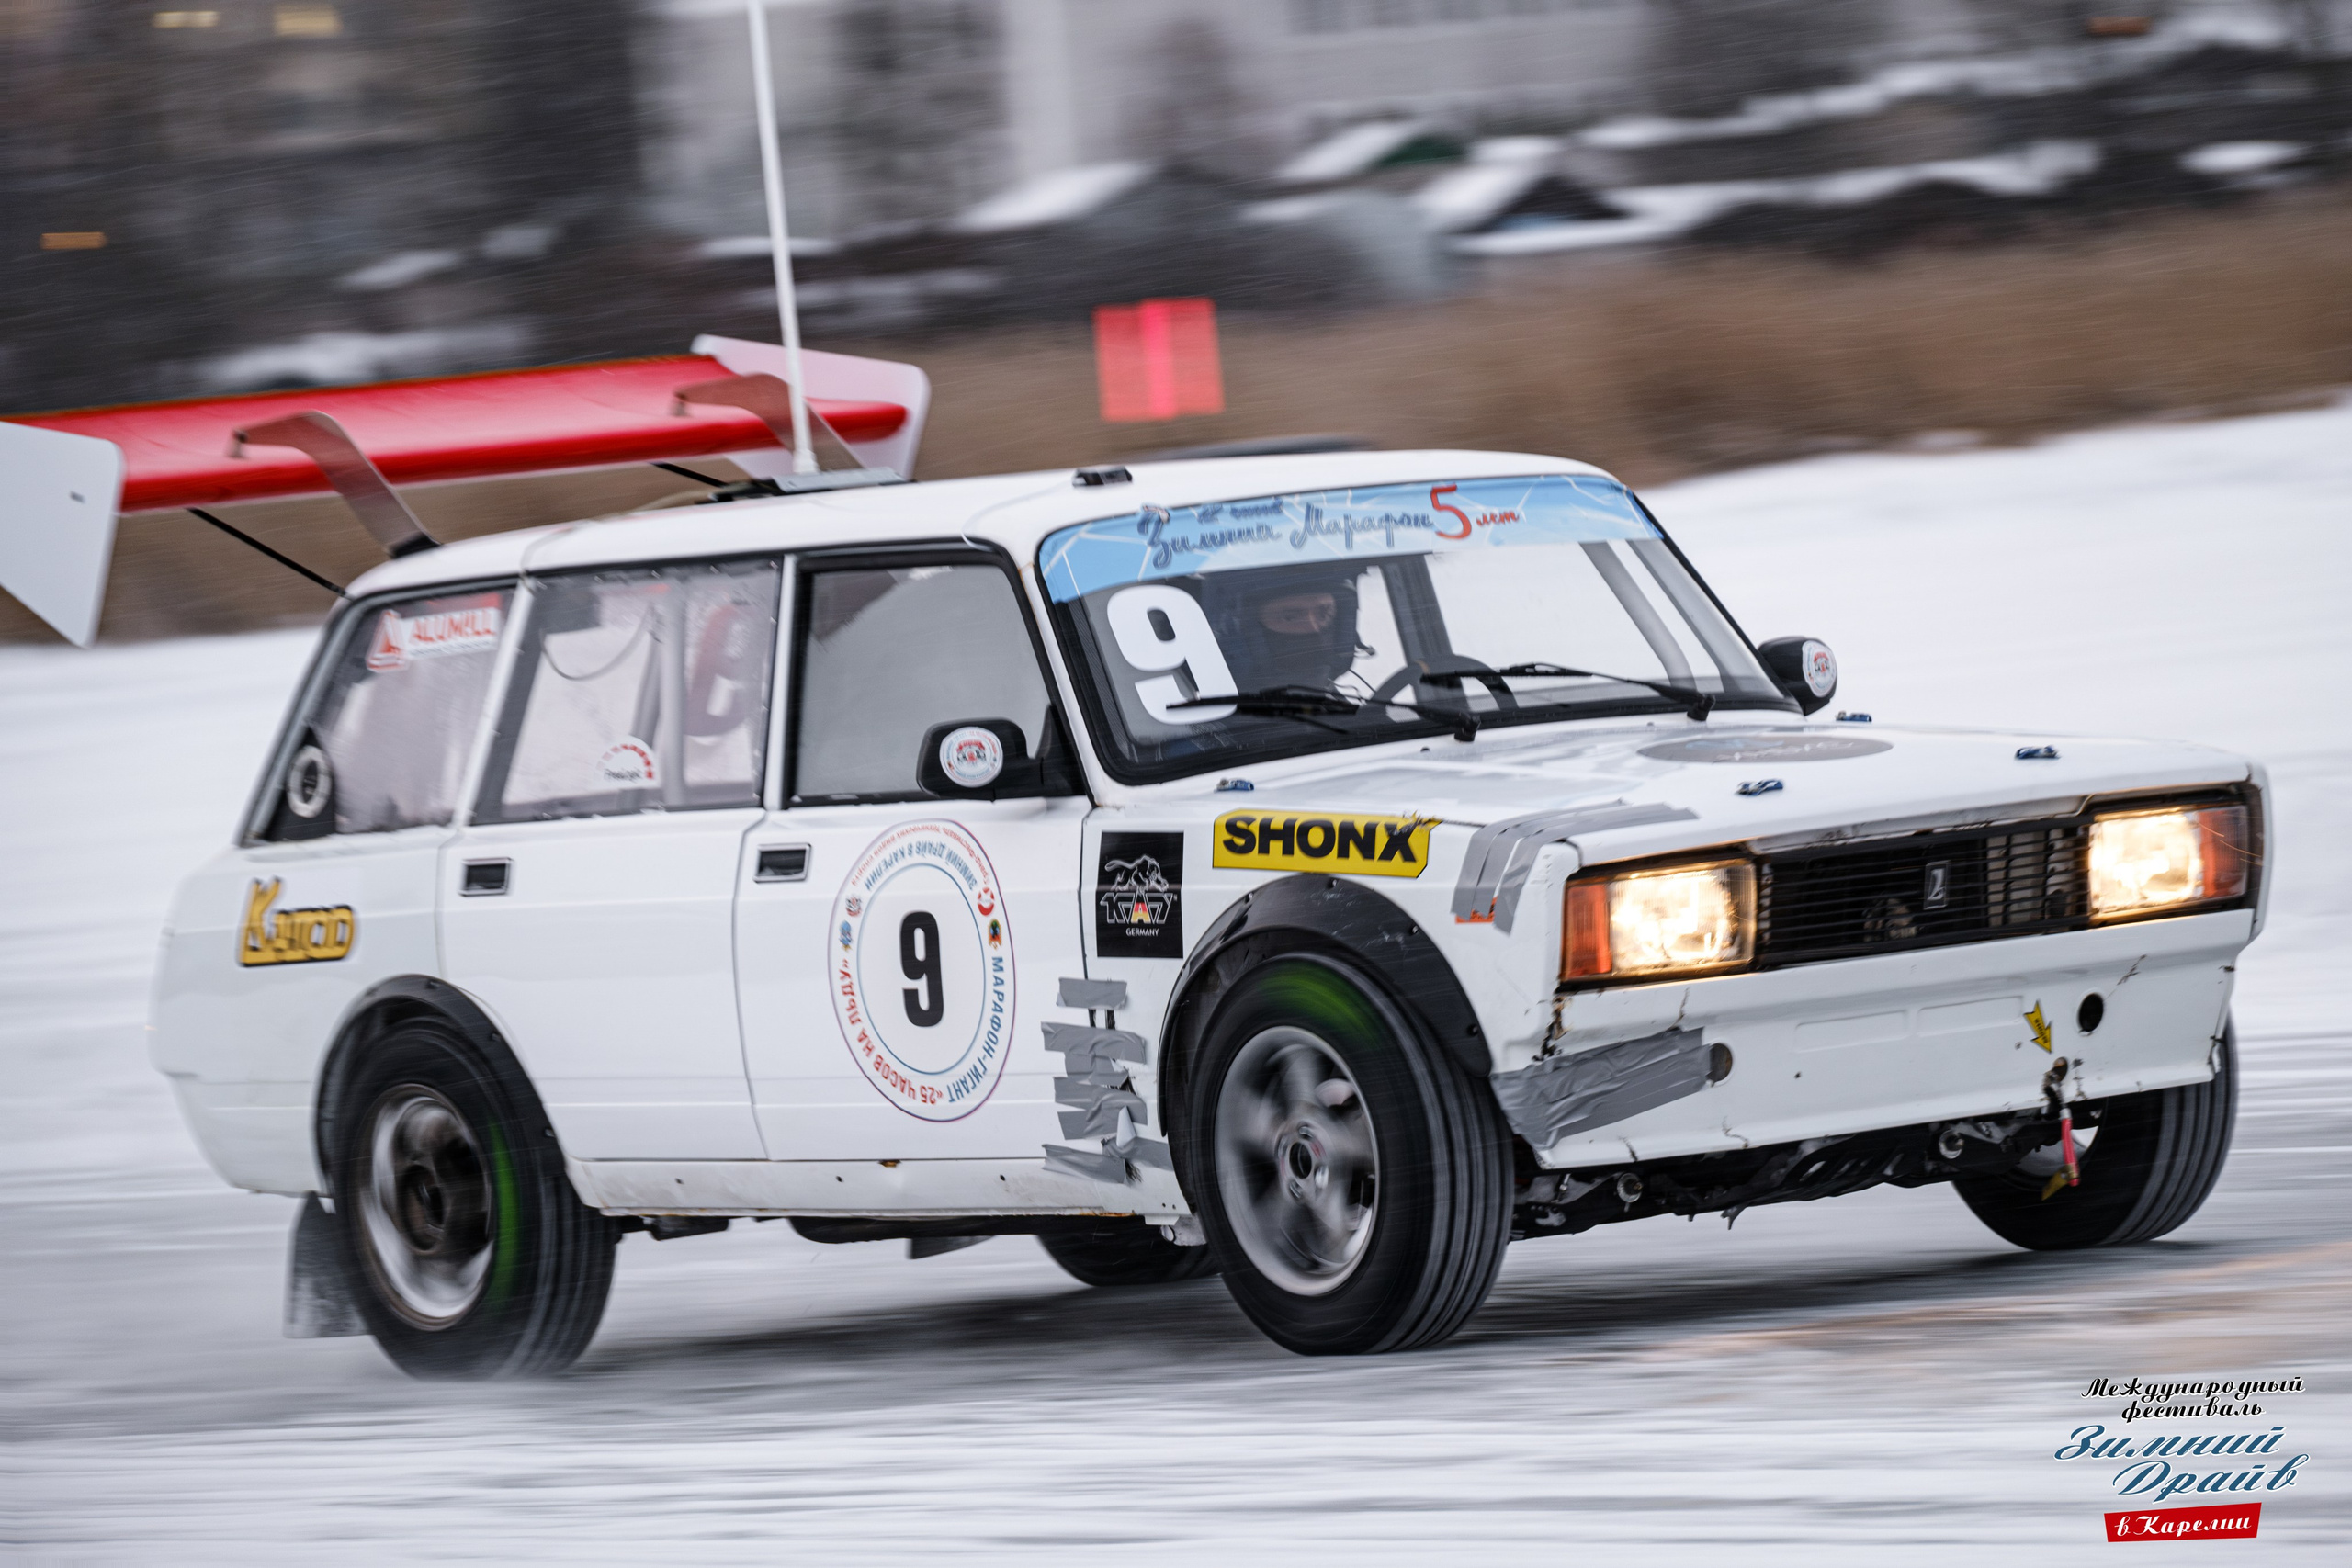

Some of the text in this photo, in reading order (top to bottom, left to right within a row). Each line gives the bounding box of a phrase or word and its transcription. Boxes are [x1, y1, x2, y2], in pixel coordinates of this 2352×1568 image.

[1289, 502, 1434, 550] Марафон
[1430, 482, 1472, 539] 5
[1107, 585, 1239, 725] 9
[1224, 815, 1418, 863] SHONX
[1125, 927, 1159, 937] GERMANY
[899, 910, 944, 1028] 9
[856, 1030, 876, 1056] НА
[948, 955, 1005, 1103] МАРАФОН-ГИГАНТ
[873, 1055, 917, 1100] ЧАСОВ
